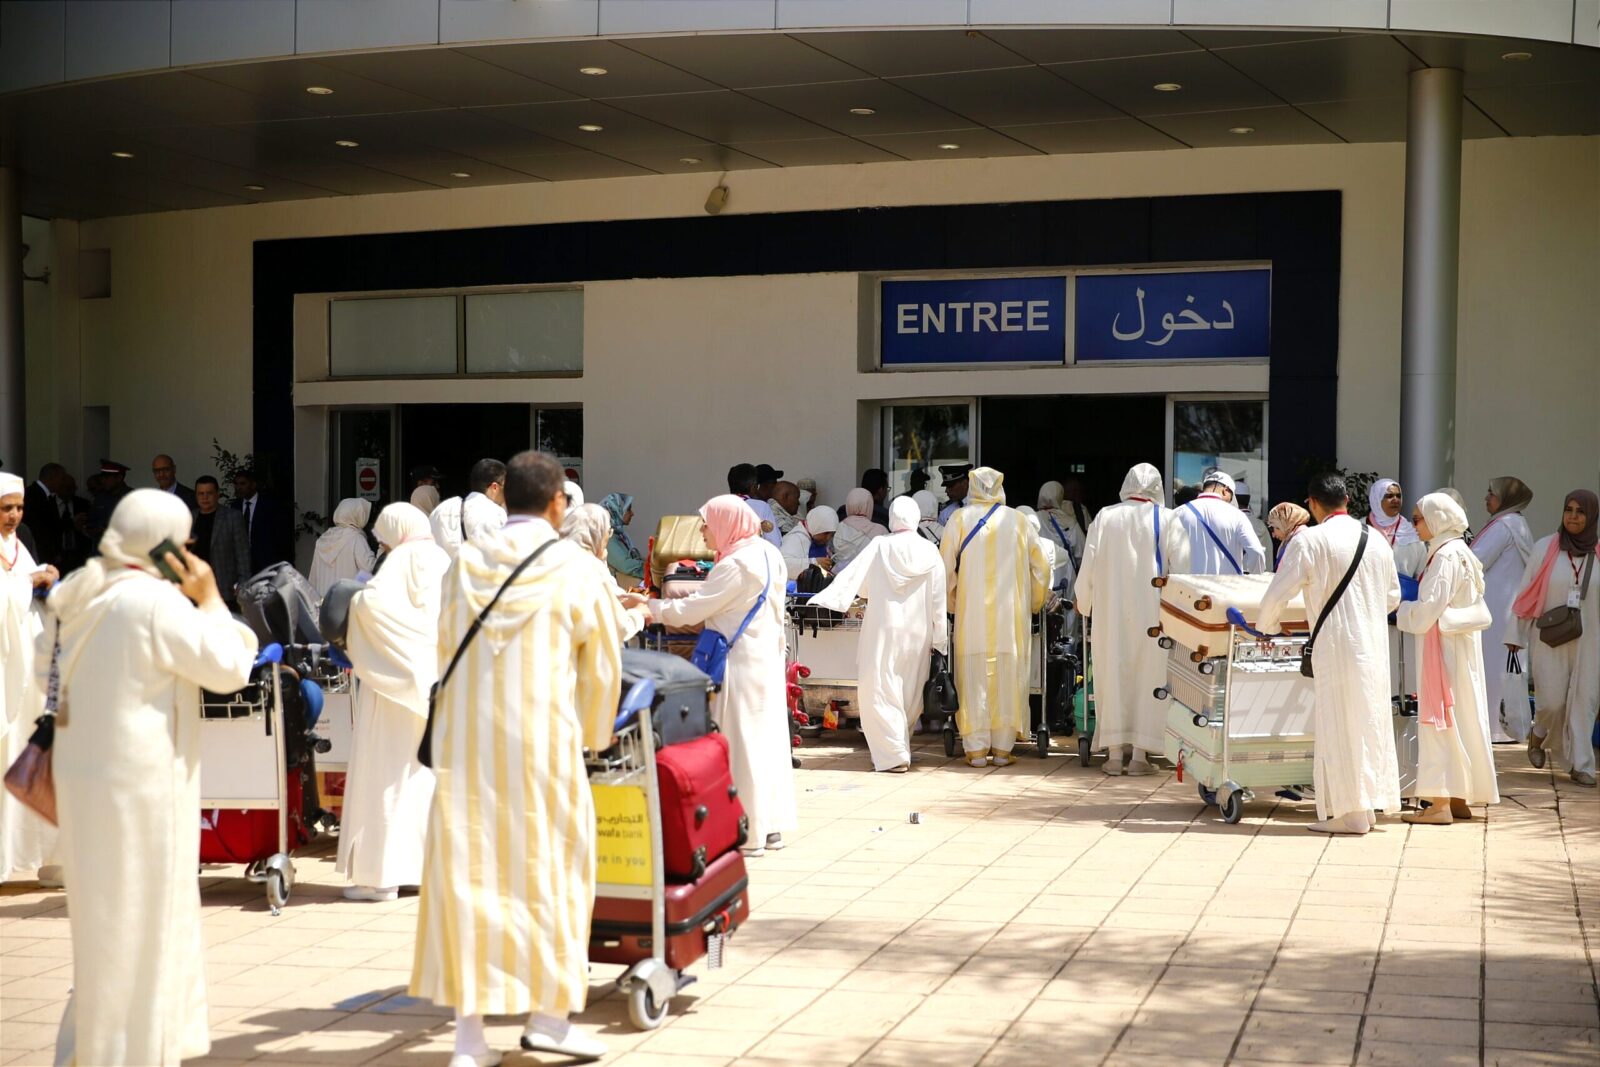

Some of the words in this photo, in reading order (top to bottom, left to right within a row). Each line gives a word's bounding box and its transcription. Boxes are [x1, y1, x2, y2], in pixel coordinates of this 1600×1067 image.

[897, 301, 1049, 334] ENTREE
[1112, 287, 1234, 346] دخول
[598, 827, 620, 837] wafa
[625, 857, 646, 868] you
